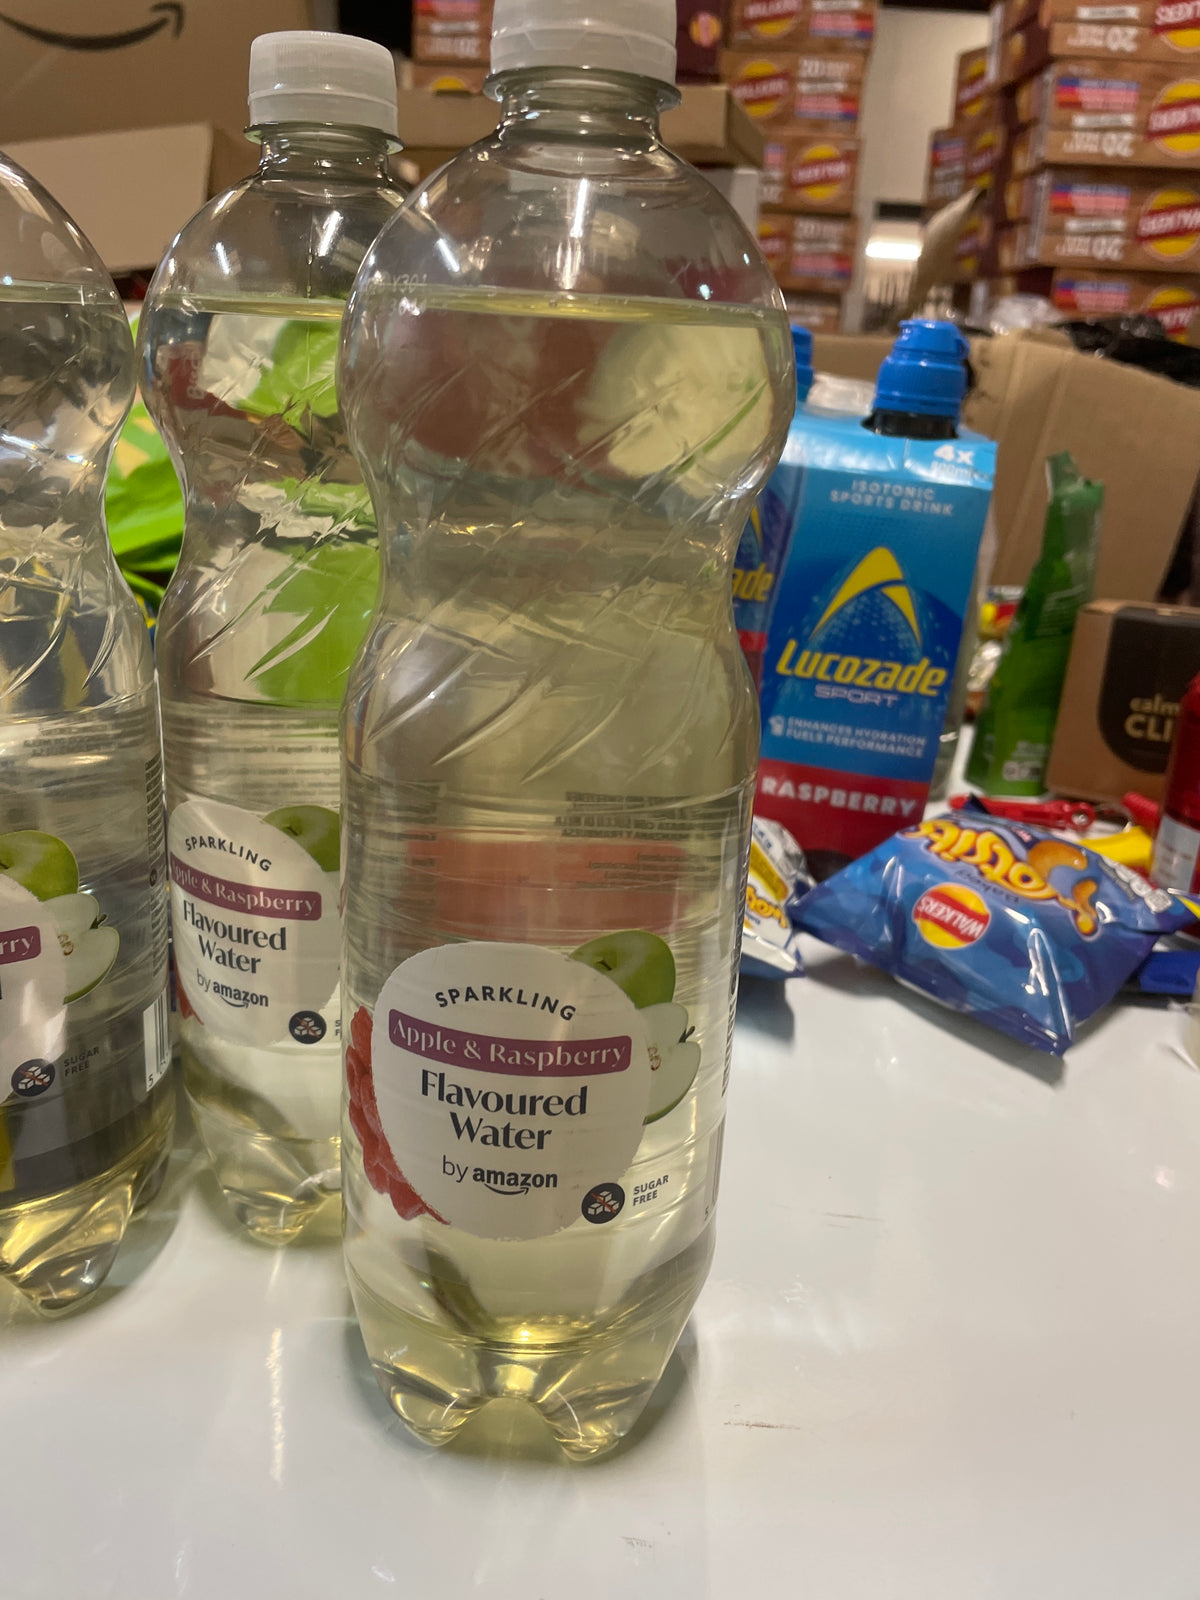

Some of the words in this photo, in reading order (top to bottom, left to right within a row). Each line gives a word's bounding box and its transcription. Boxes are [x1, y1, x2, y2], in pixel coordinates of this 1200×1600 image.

[830, 491, 895, 509] SPORTS
[899, 497, 953, 516] DRINK
[852, 479, 934, 500] ISOTONIC
[776, 639, 946, 696] Lucozade
[814, 684, 898, 707] SPORT
[785, 727, 823, 742] FUELS
[826, 732, 924, 758] PERFORMANCE
[855, 726, 926, 744] HYDRATION
[761, 776, 917, 817] RASPBERRY
[185, 834, 272, 872] SPARKLING
[201, 879, 213, 897] &
[215, 882, 316, 915] Raspberry
[183, 899, 287, 951] Flavoured
[916, 895, 990, 938] WALKERS
[198, 934, 262, 974] Water
[197, 968, 211, 993] by
[213, 980, 269, 1007] amazon
[435, 985, 577, 1021] SPARKLING
[64, 1046, 100, 1067] SUGAR
[393, 1018, 456, 1054] Apple
[463, 1040, 481, 1060] &
[489, 1043, 626, 1071] Raspberry
[64, 1061, 90, 1077] FREE
[421, 1068, 588, 1116] Flavoured
[450, 1112, 552, 1150] Water
[442, 1155, 469, 1183] by
[472, 1167, 558, 1189] amazon
[633, 1174, 669, 1195] SUGAR
[632, 1190, 658, 1207] FREE
